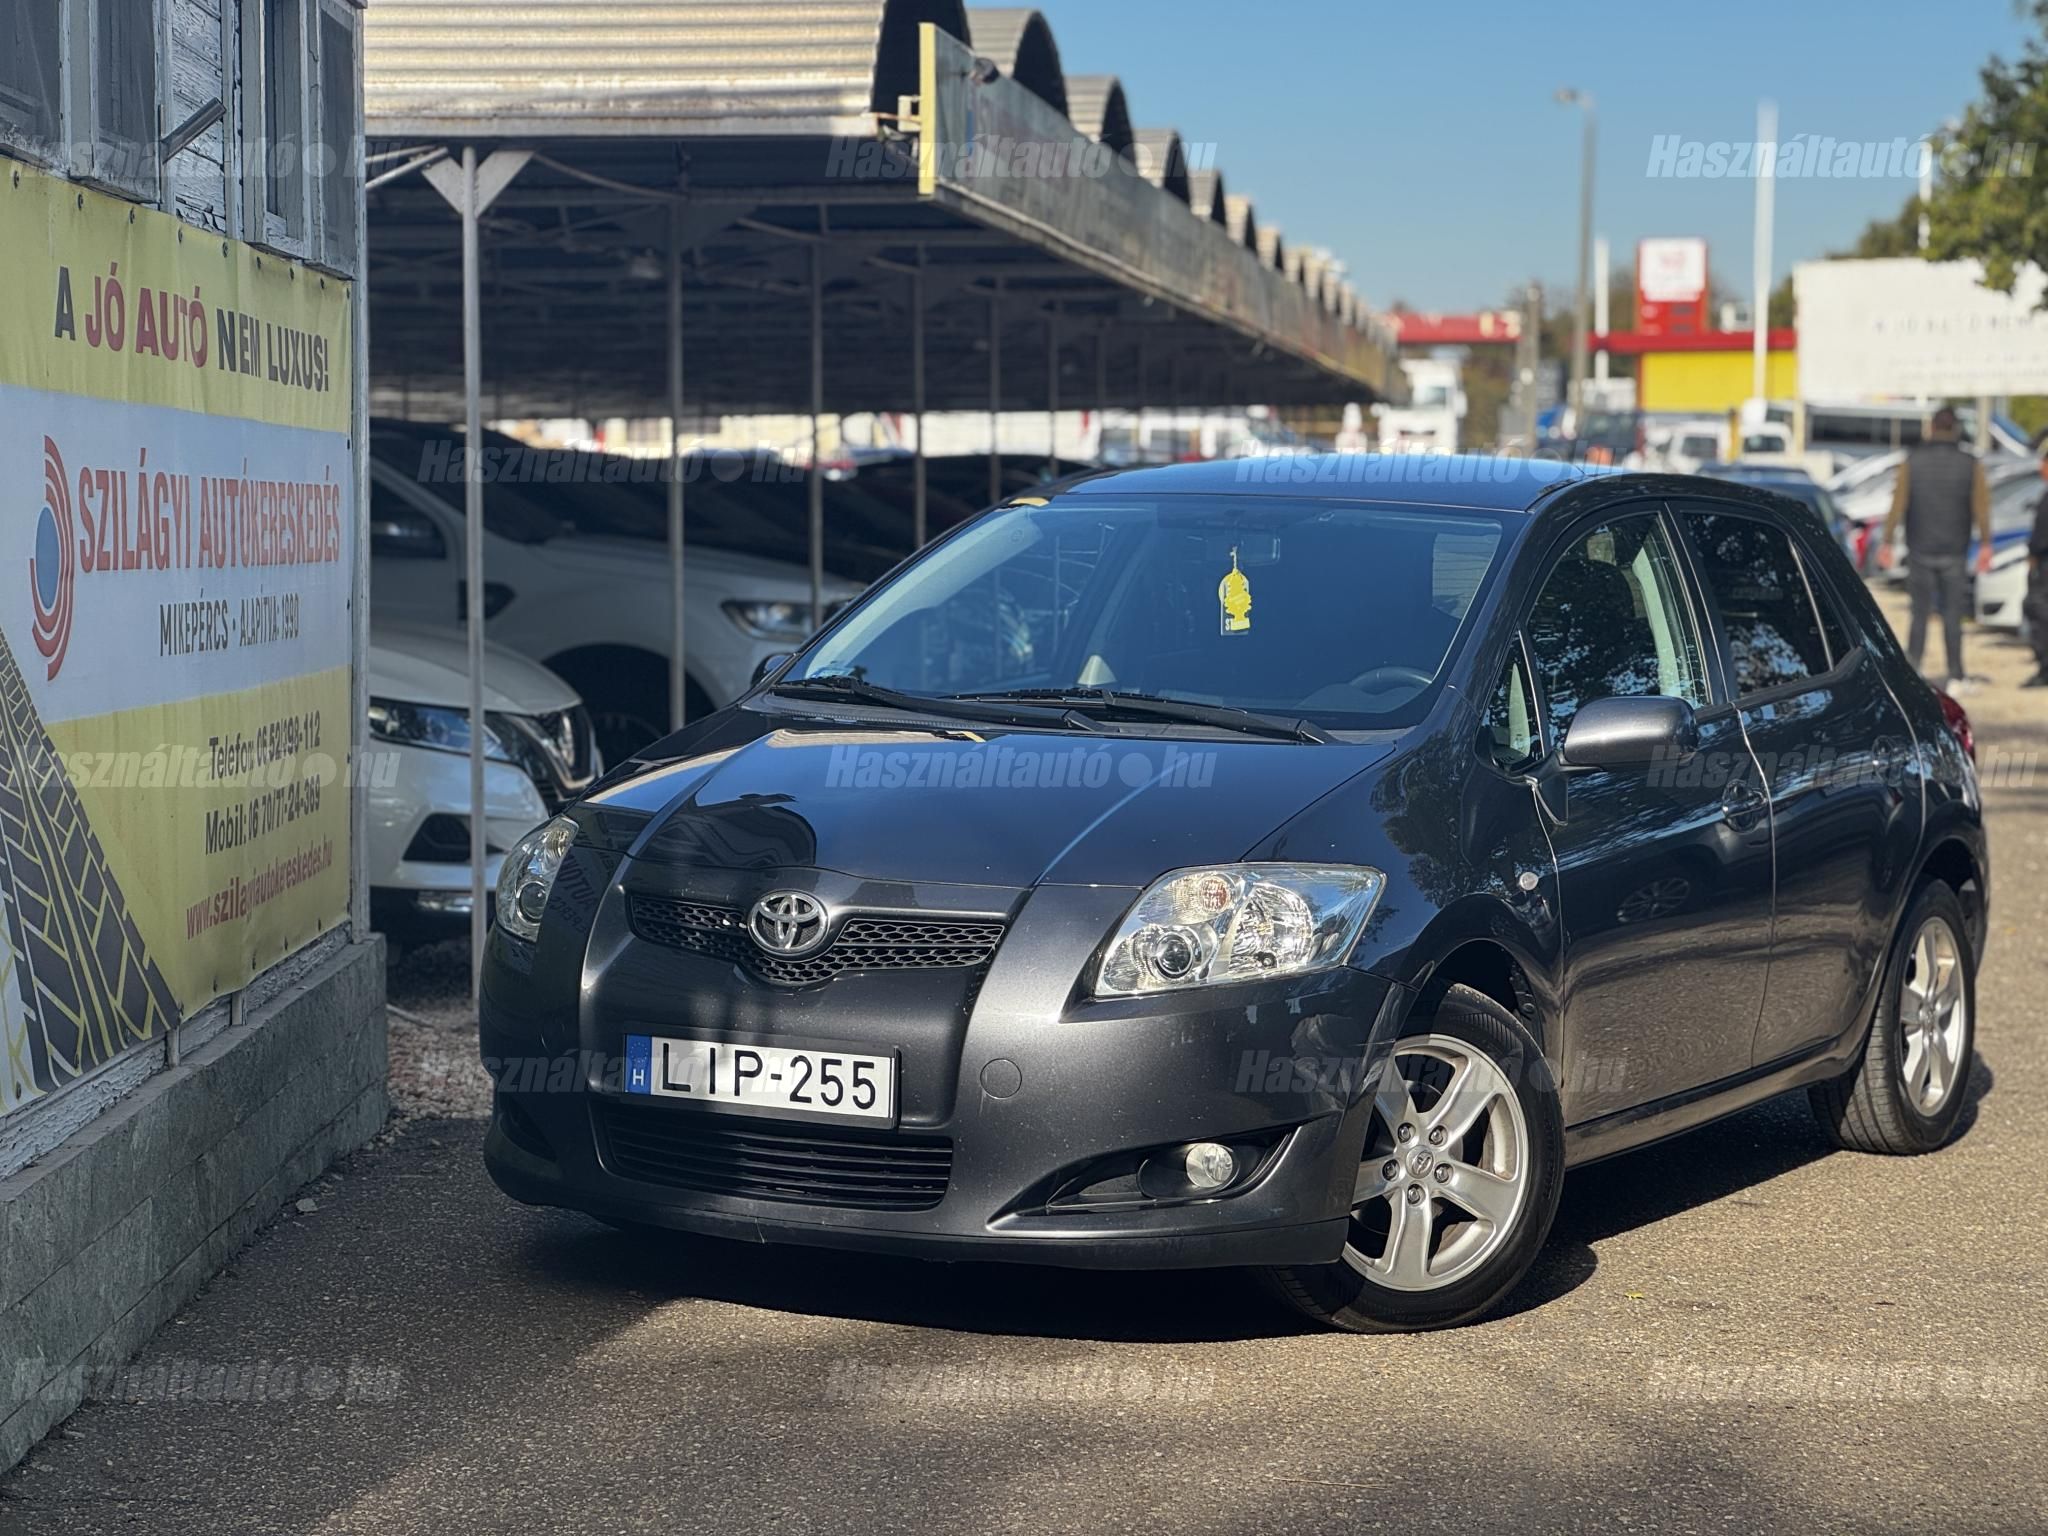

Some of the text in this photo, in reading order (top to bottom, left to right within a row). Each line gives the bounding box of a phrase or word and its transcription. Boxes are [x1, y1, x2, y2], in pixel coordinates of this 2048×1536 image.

[55, 261, 329, 392] A JÓ AUTÓ NEM LUXUS!
[79, 448, 340, 574] SZILÁGYI AUTÓKERESKEDÉS
[160, 584, 300, 657] MIKEPÉRCS ALAPÍTVA: 1990
[257, 725, 268, 767] 06
[206, 803, 247, 856] Mobil:
[248, 798, 259, 840] 06
[632, 1042, 877, 1111] H LIP-255
